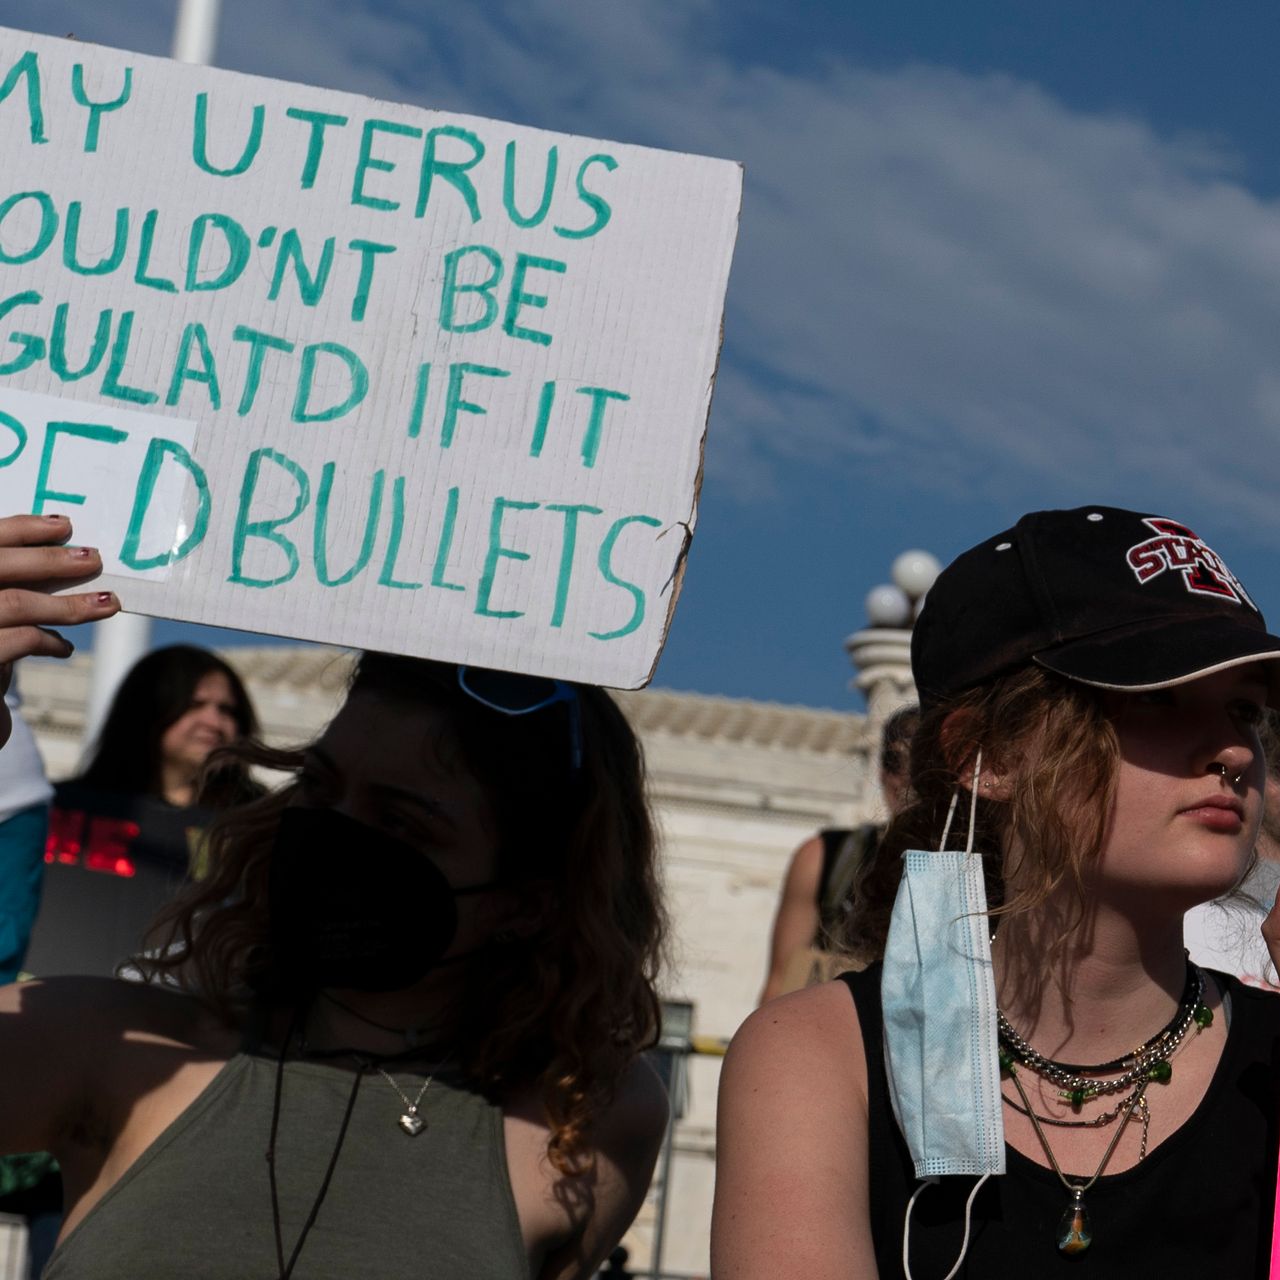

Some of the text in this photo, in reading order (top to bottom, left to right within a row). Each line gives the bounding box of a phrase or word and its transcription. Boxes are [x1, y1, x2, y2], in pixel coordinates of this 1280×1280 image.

[193, 92, 620, 240] UTERUS
[0, 190, 568, 347] OULDN'T BE
[0, 290, 631, 469] GULATD IF IT
[227, 446, 663, 642] BULLETS
